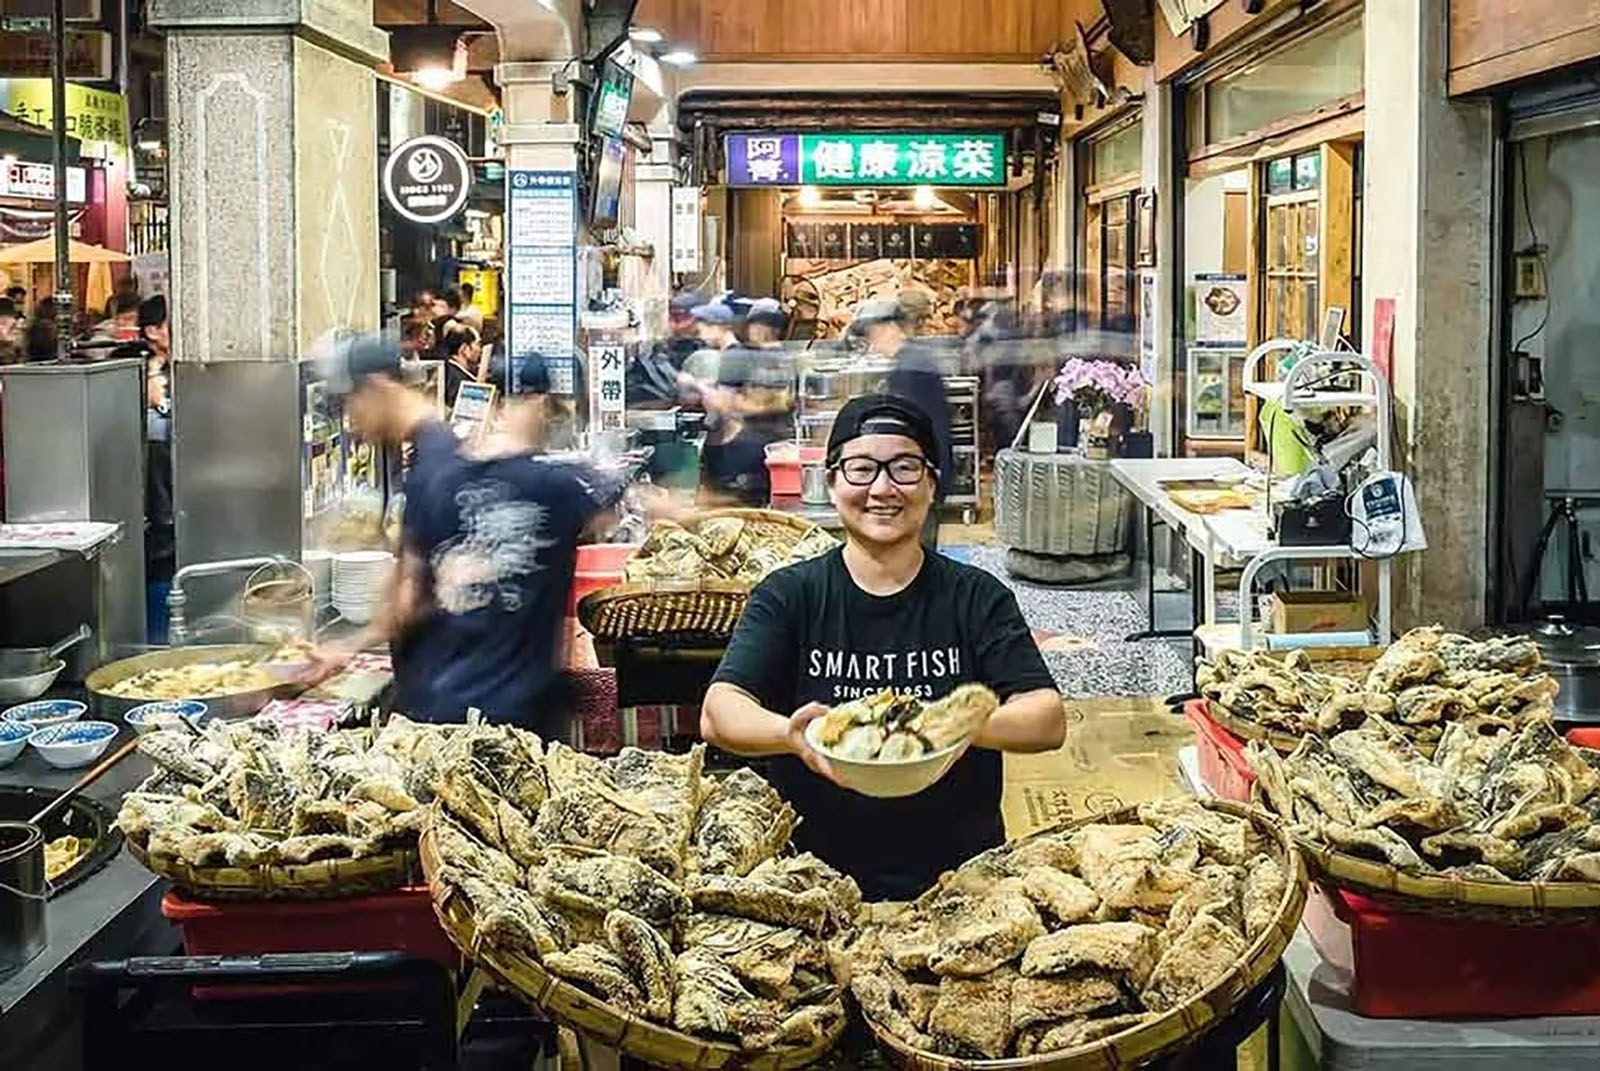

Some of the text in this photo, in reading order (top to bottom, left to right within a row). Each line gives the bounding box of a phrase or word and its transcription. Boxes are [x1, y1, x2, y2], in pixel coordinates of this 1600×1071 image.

[811, 140, 995, 179] 健康涼菜
[809, 647, 960, 680] SMART FISH
[833, 685, 884, 698] SINCE
